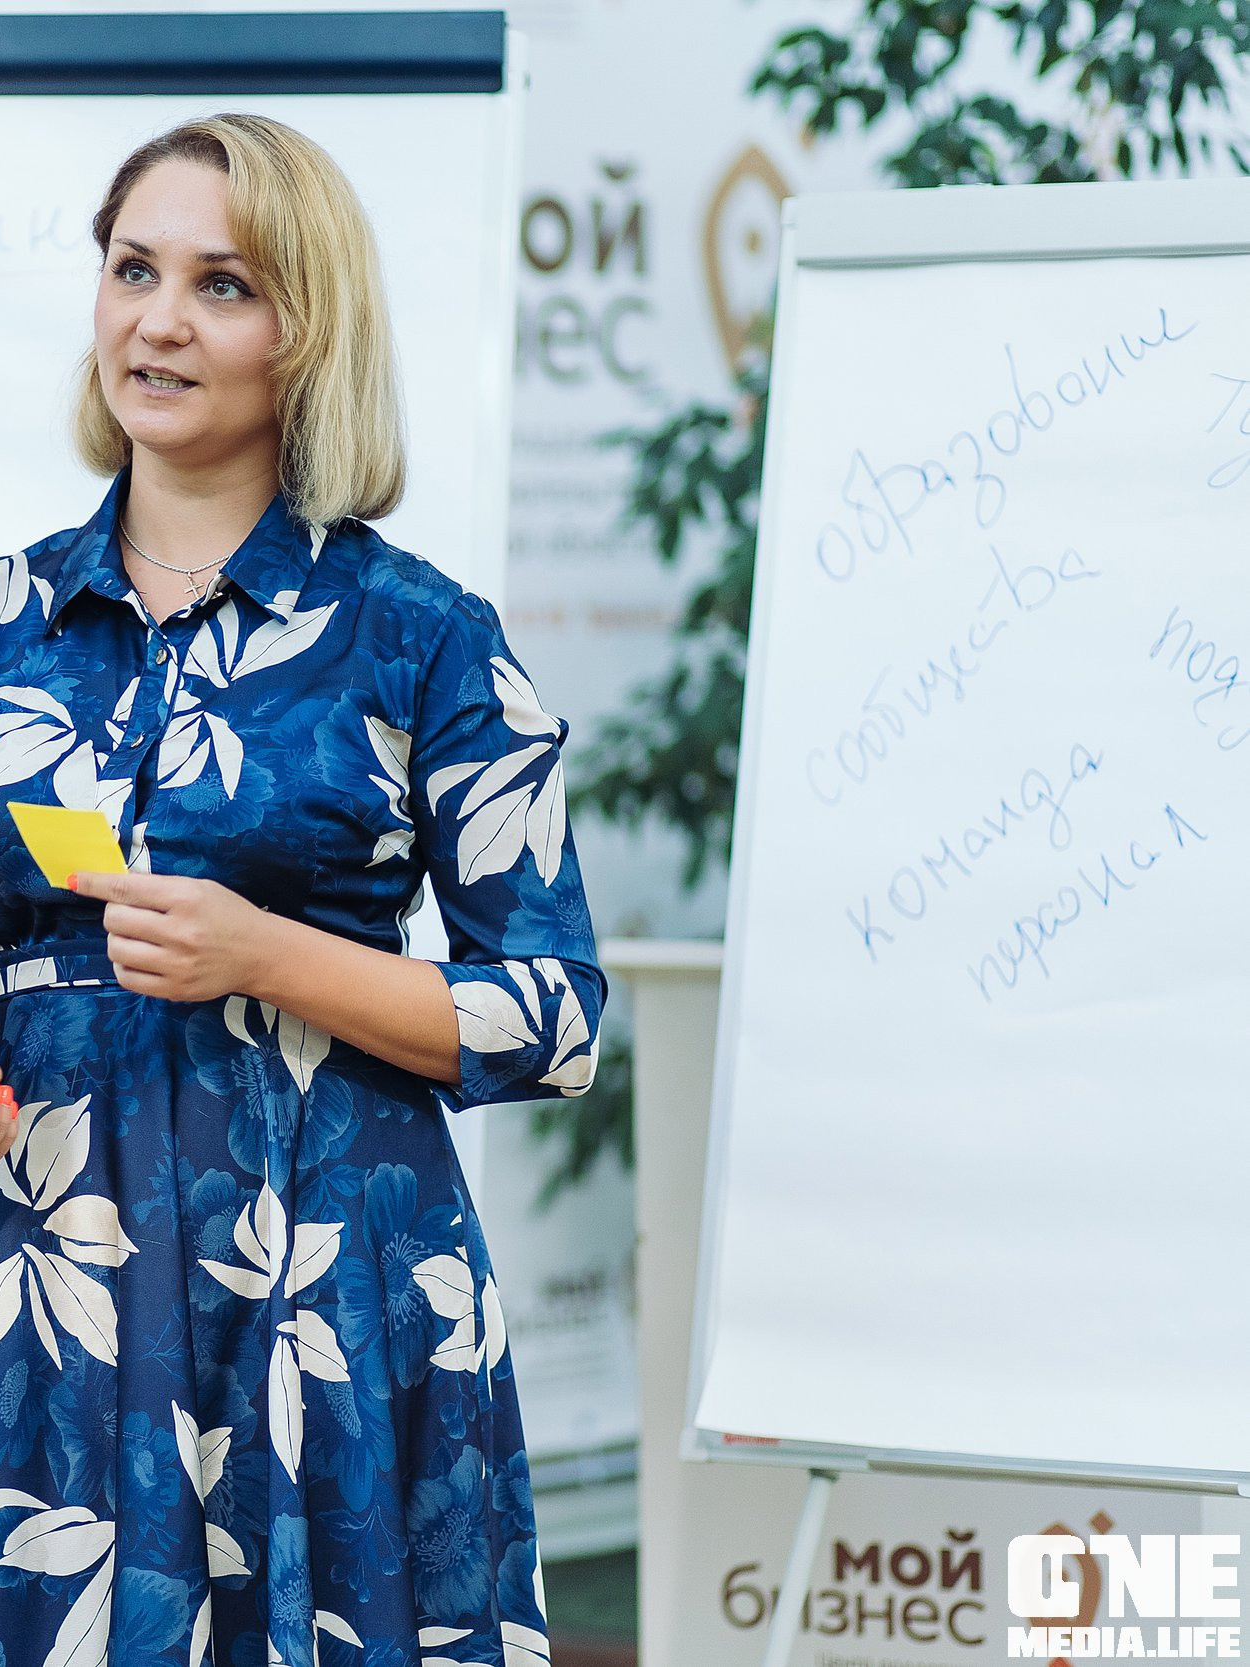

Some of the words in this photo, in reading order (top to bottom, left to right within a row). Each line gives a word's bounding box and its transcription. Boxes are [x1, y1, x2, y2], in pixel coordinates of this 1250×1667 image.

[518, 158, 646, 276] ой
[846, 742, 1105, 965] команда
[833, 1528, 982, 1592] мой
